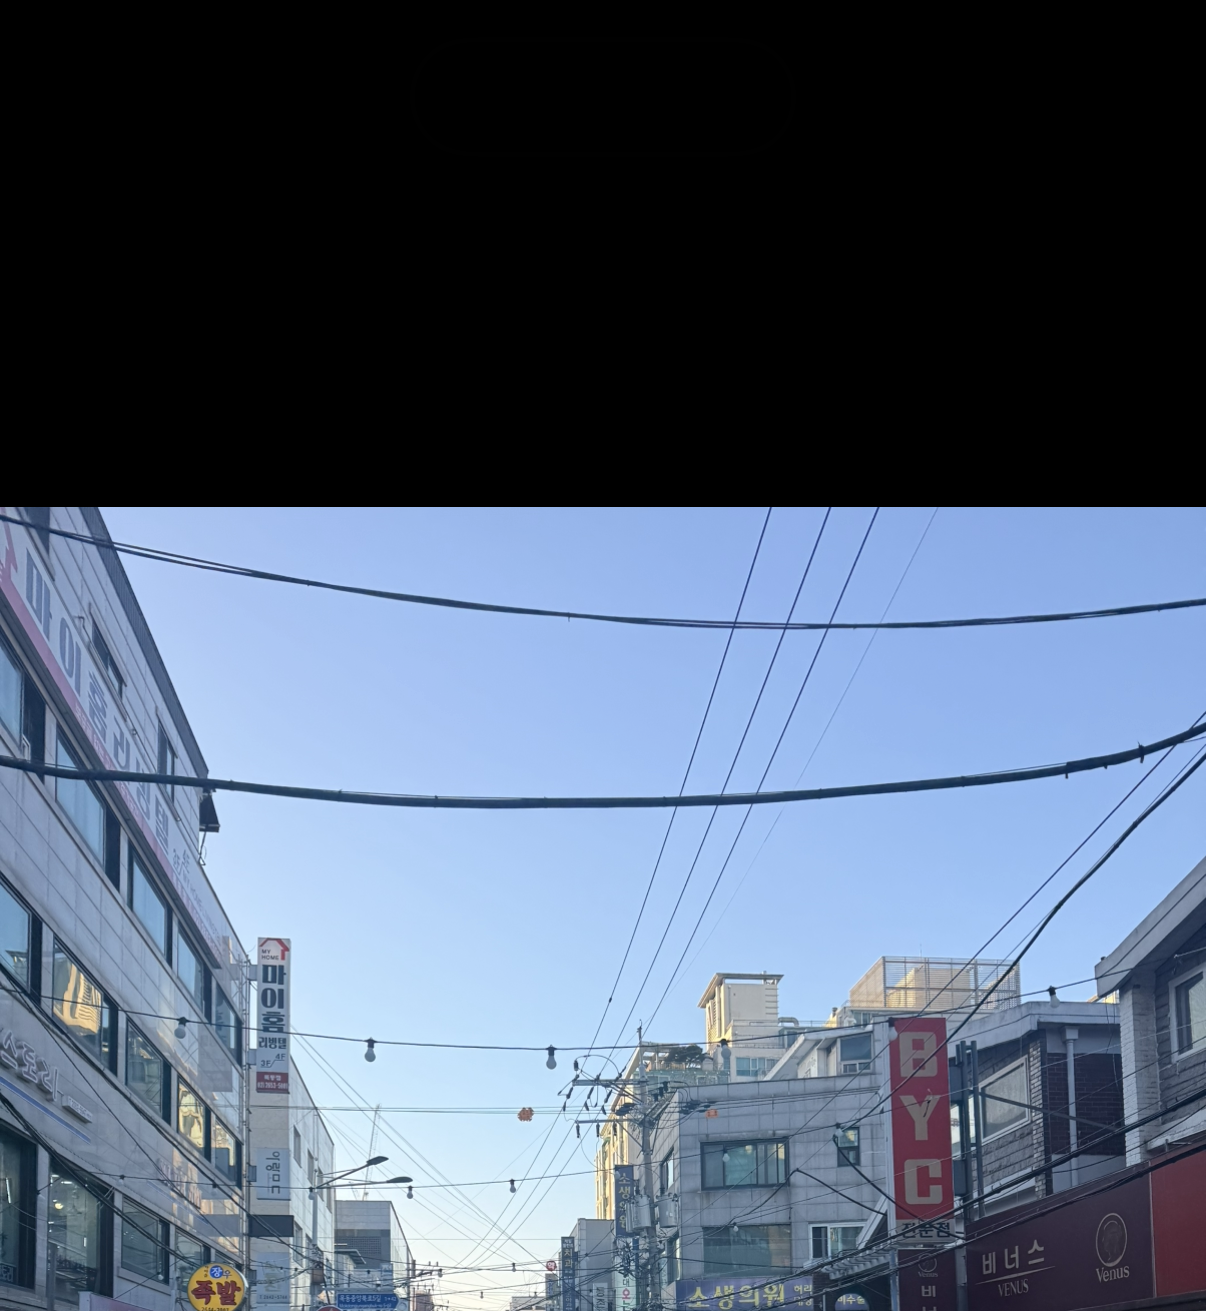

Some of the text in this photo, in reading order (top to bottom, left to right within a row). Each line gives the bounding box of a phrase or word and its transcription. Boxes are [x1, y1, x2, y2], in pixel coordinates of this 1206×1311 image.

[261, 964, 286, 1033] 마이홈
[258, 1037, 287, 1049] 리빙텔
[900, 1031, 943, 1205] BYC
[982, 1239, 1045, 1275] 비너스
[998, 1278, 1029, 1297] VENUS
[1096, 1266, 1130, 1283] Venus
[191, 1280, 242, 1306] 족발
[687, 1283, 785, 1310] 소생의원
[794, 1284, 813, 1296] 허리
